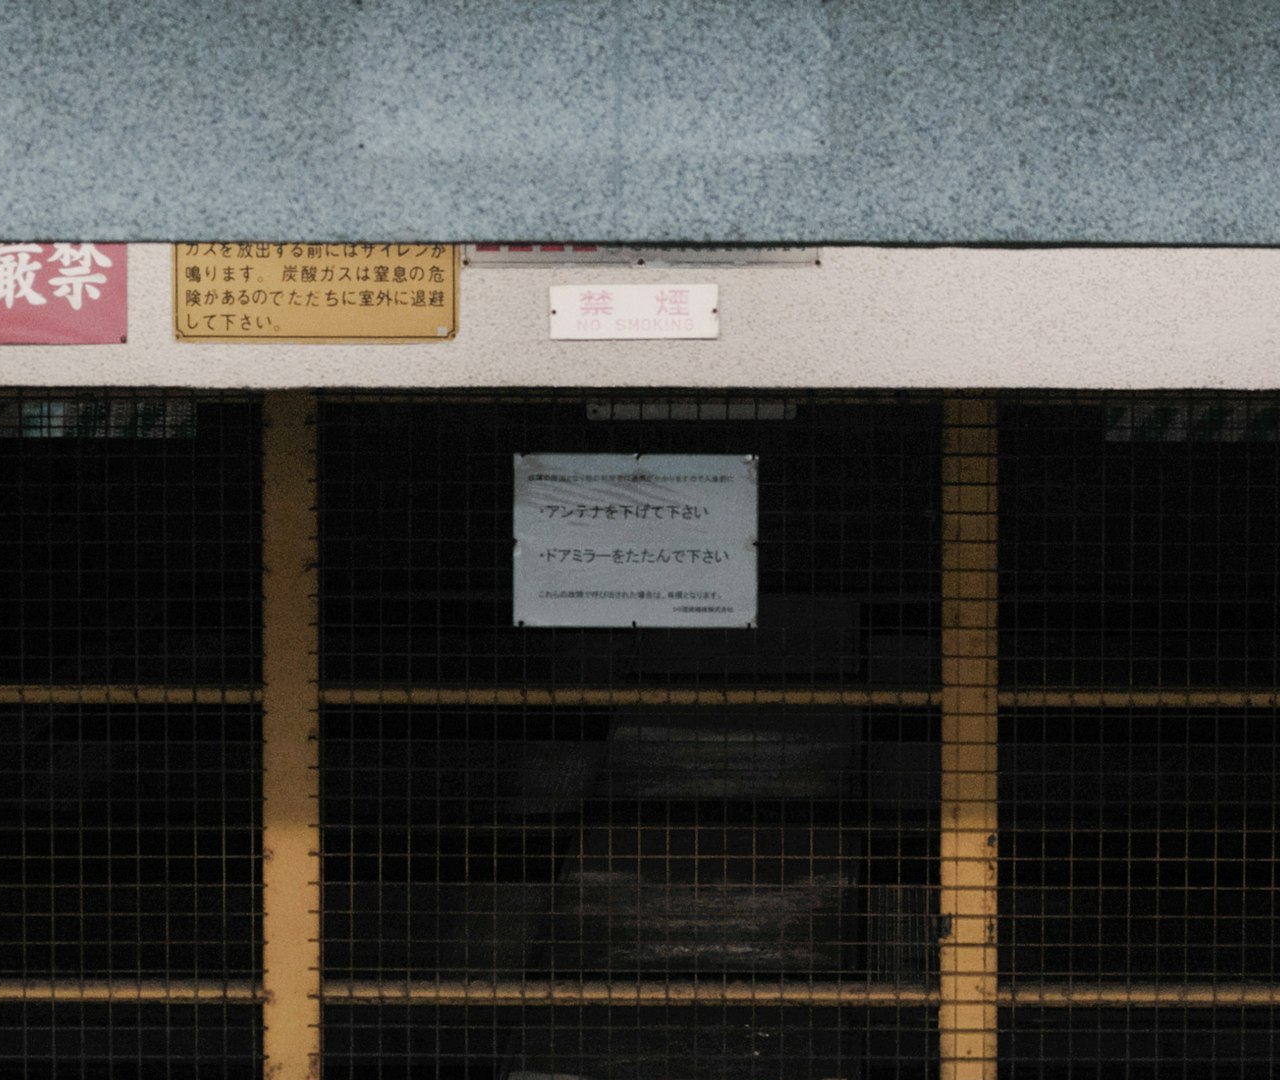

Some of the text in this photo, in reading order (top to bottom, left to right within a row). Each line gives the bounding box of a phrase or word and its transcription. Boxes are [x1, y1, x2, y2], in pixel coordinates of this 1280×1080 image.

[185, 289, 446, 307] 険があるのでただちに室外に退避
[185, 313, 282, 332] して下さい。
[577, 319, 696, 331] NO SMOKING
